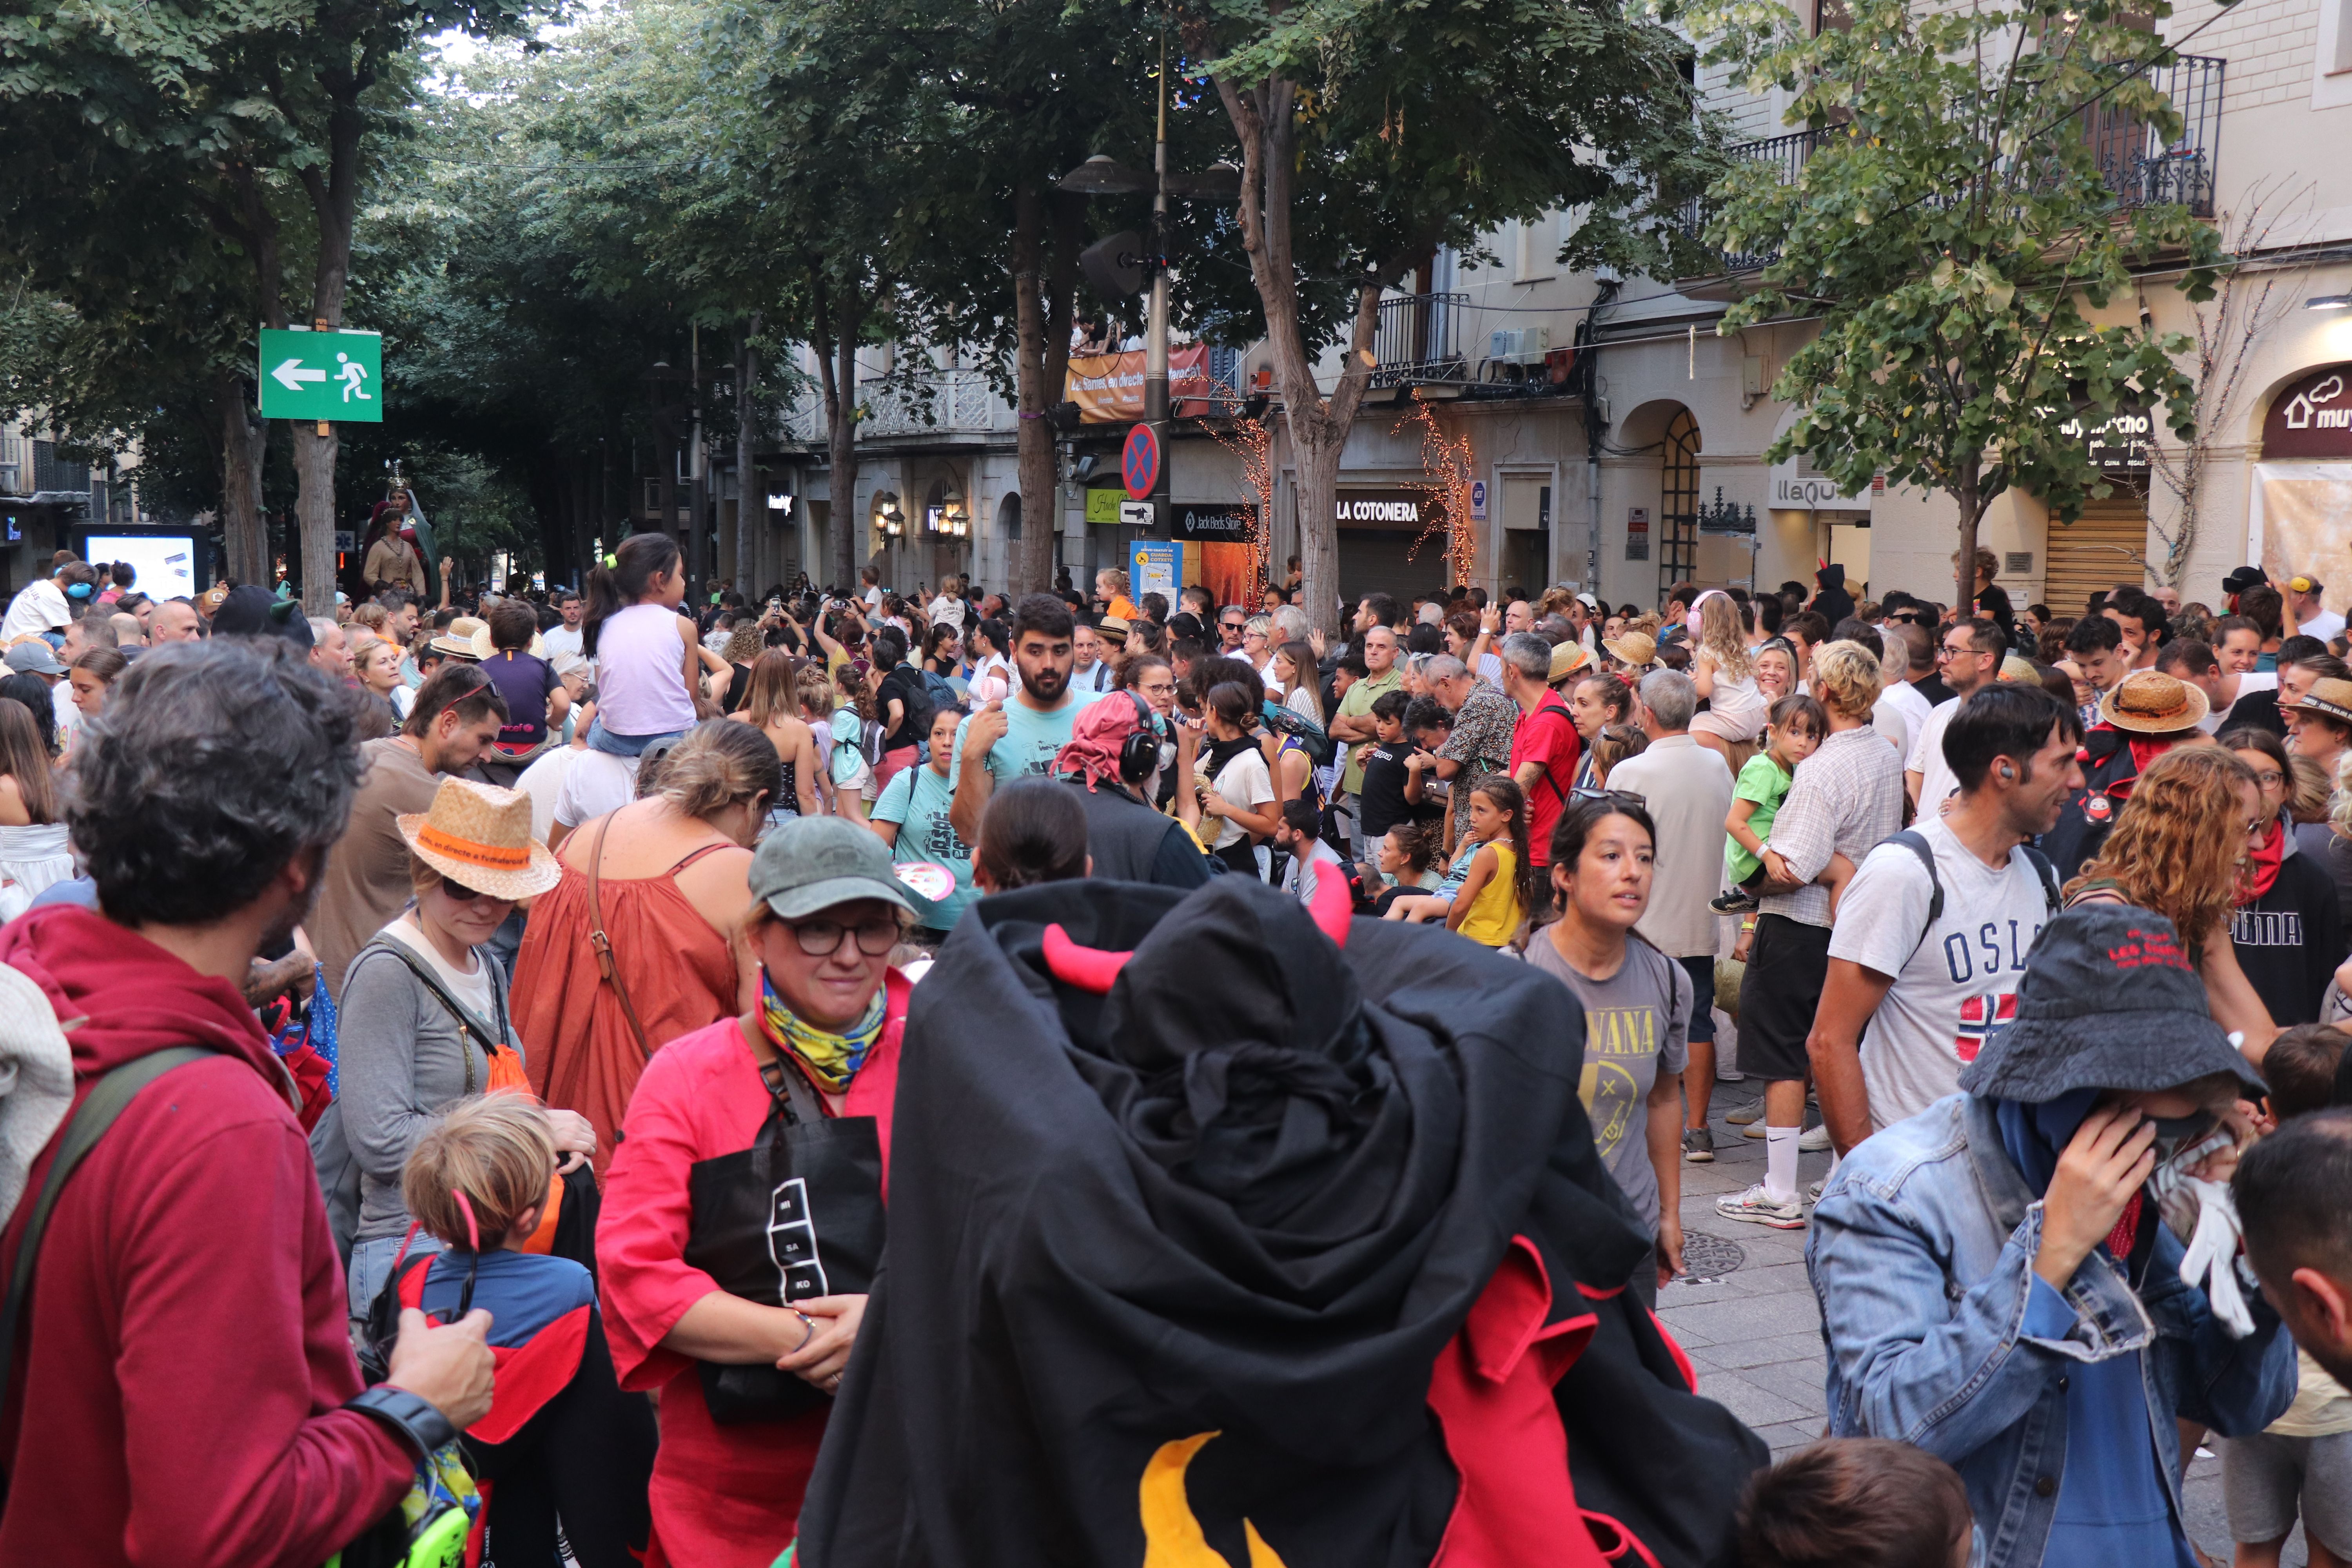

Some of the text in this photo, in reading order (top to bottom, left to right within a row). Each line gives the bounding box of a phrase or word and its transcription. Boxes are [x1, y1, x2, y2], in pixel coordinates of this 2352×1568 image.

[1083, 376, 1107, 391] Santes,
[1108, 377, 1118, 388] en
[1119, 372, 1144, 387] directe
[1474, 490, 1483, 499] ADT
[1337, 501, 1419, 522] LA COTONERA
[1196, 515, 1241, 530] Jack Beds Store
[500, 723, 523, 731] nicef
[443, 844, 471, 857] directe
[2228, 910, 2303, 946] UMA
[1943, 919, 2042, 984] OSL
[1584, 1009, 1655, 1054] VANA
[786, 1243, 800, 1252] SA
[796, 1279, 811, 1292] KO
